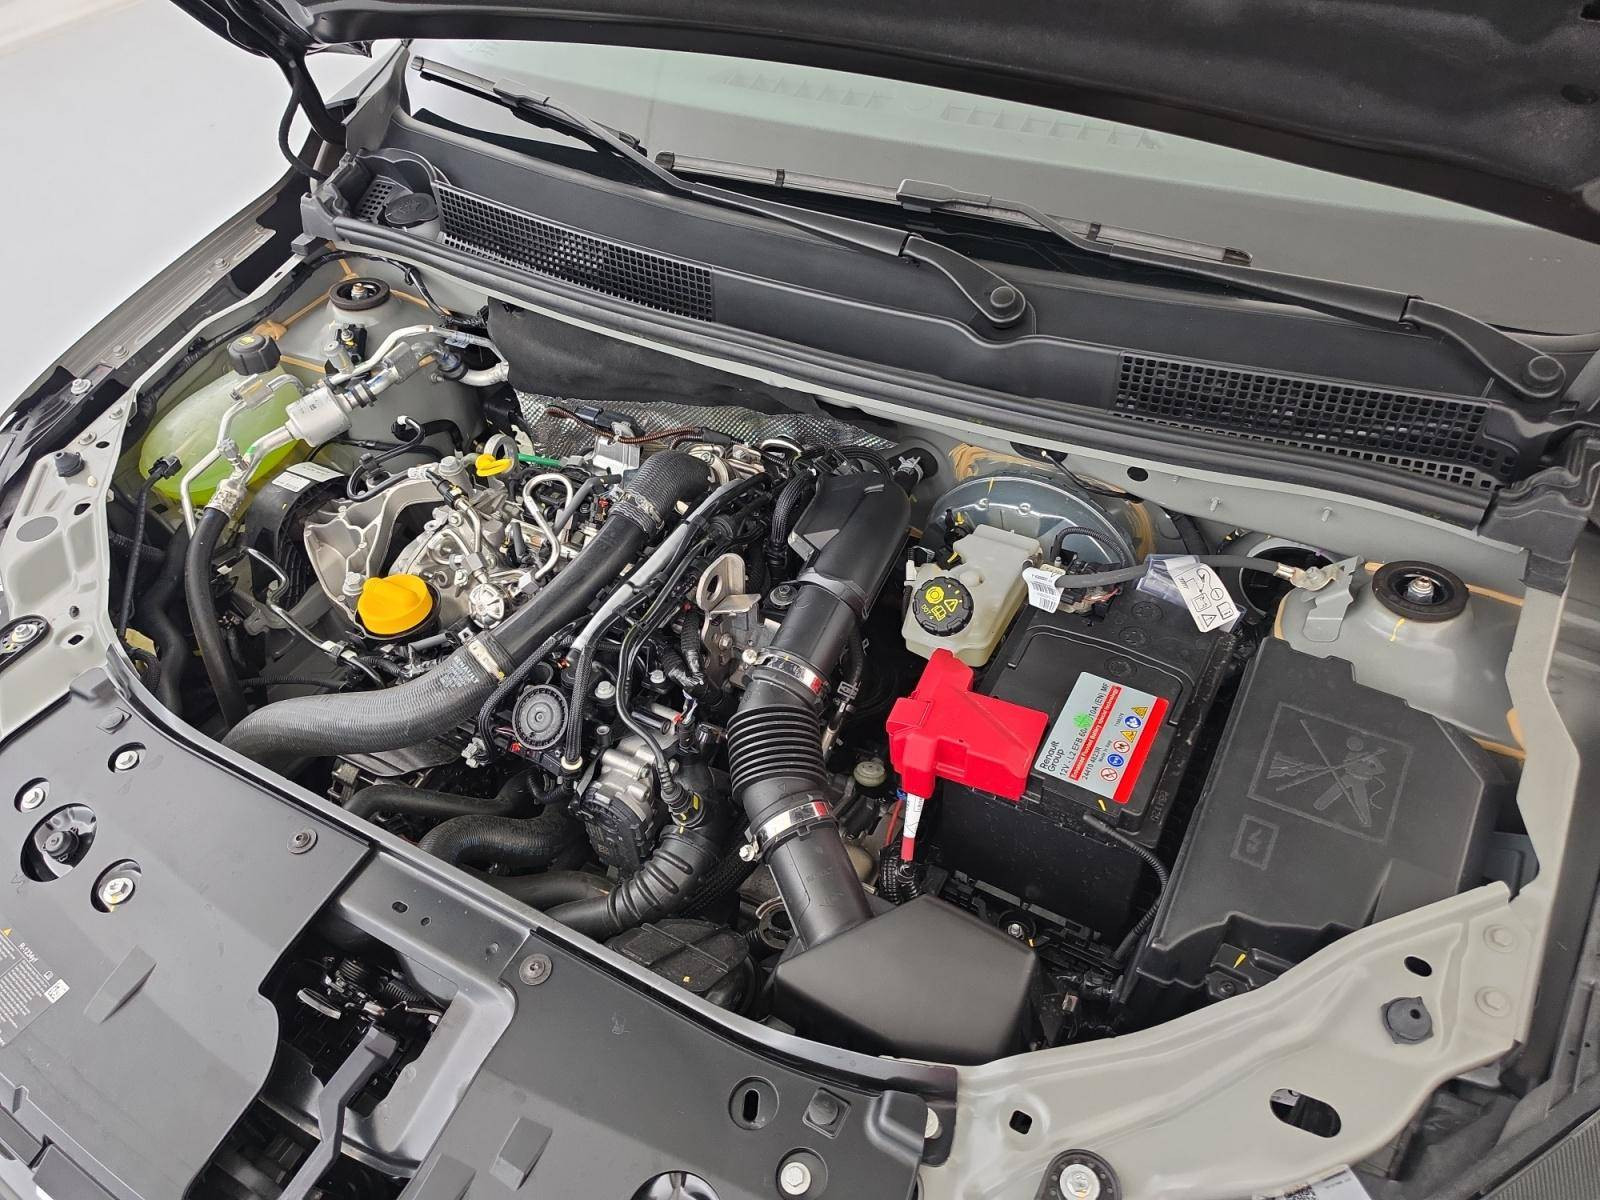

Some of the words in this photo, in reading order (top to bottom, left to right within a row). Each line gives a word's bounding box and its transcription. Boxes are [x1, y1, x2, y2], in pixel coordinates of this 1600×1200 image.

[1040, 741, 1059, 769] Renault
[1047, 749, 1065, 772] Group
[1060, 764, 1069, 775] 12V
[1067, 751, 1076, 760] L2
[1072, 737, 1083, 751] EFB
